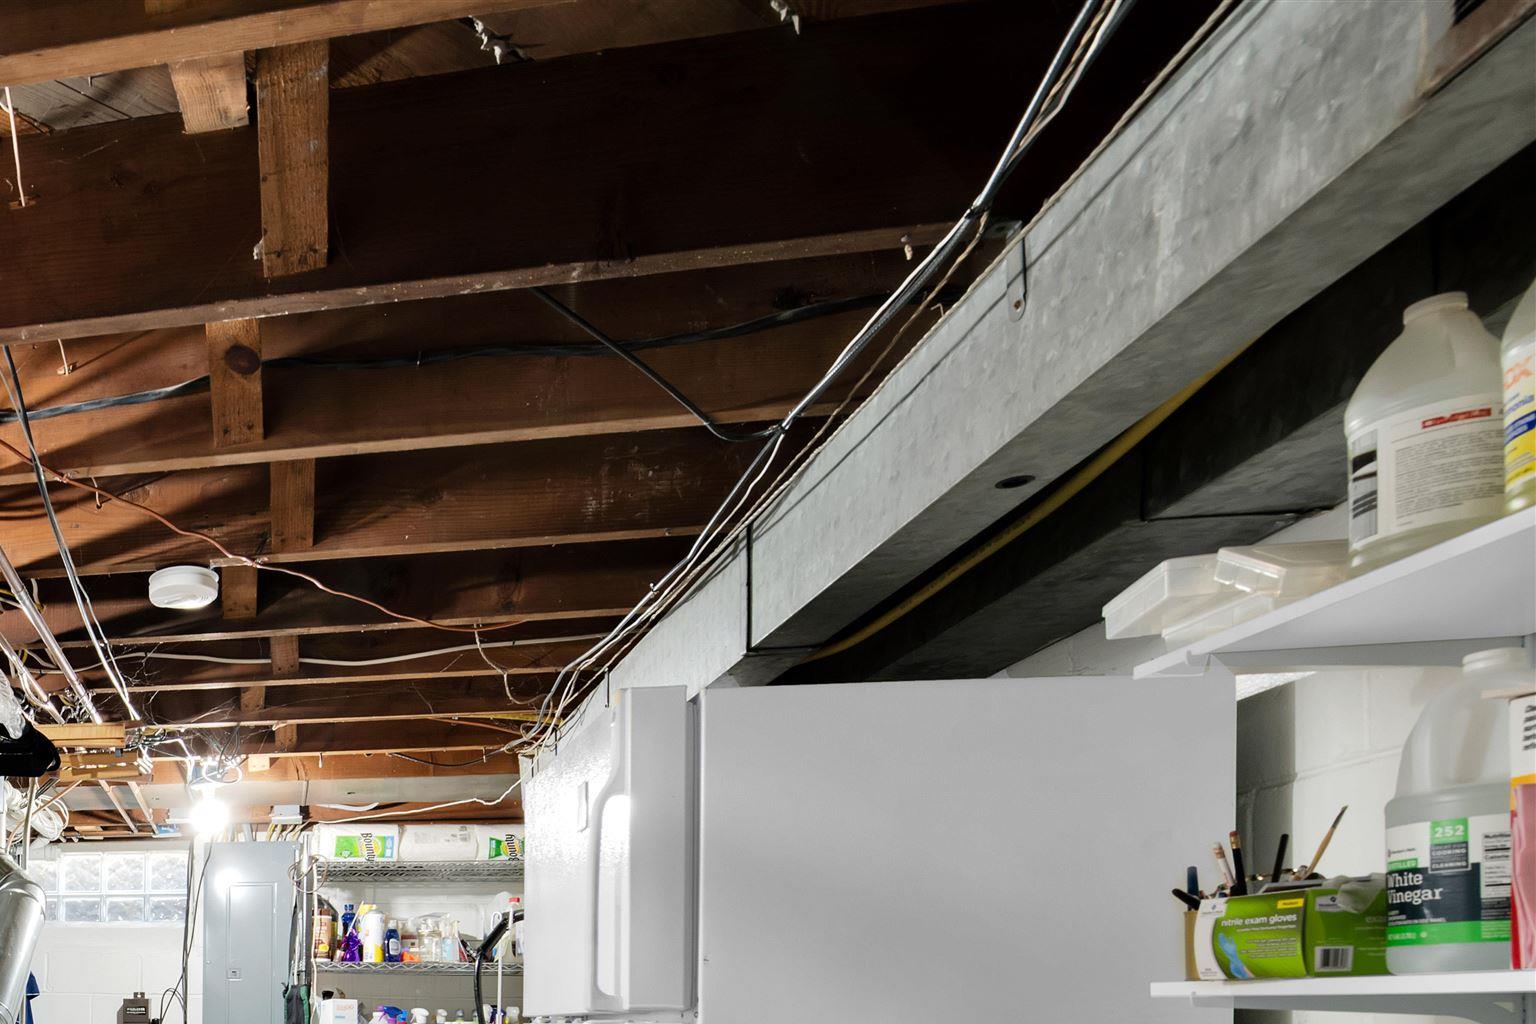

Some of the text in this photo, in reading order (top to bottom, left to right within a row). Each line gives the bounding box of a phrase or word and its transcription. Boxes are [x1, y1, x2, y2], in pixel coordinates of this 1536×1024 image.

[1434, 825, 1465, 838] 252
[361, 833, 376, 862] Bounty
[505, 834, 520, 861] Bounty
[1221, 913, 1297, 926] nitrile exam gloves
